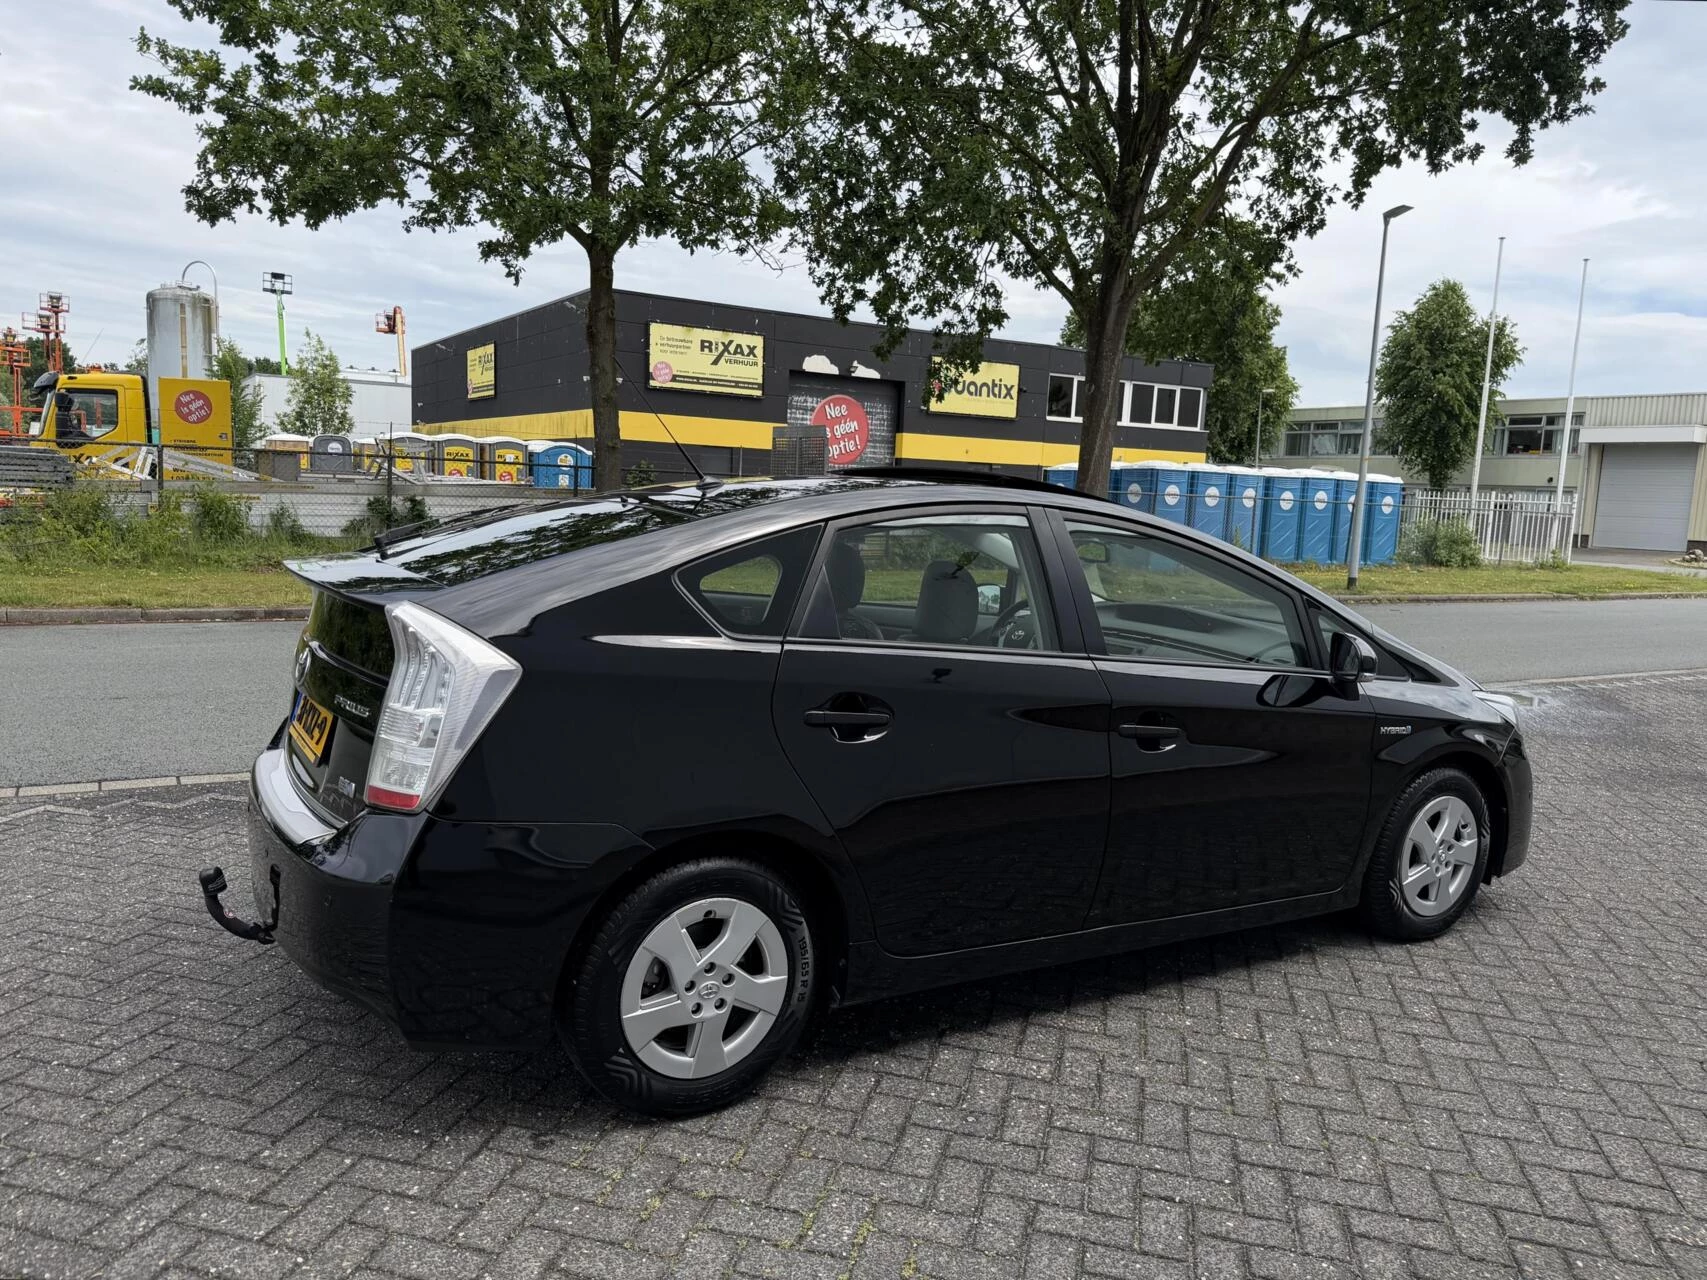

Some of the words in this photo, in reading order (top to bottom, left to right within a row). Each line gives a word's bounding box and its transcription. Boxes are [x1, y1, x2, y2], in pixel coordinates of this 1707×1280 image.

[724, 358, 759, 368] VERHUUR
[944, 378, 1015, 400] uantix
[179, 393, 196, 404] Nee
[825, 403, 848, 420] Nee
[834, 417, 859, 438] géén
[334, 694, 370, 717] PRIUS
[1380, 726, 1407, 735] HYBRID
